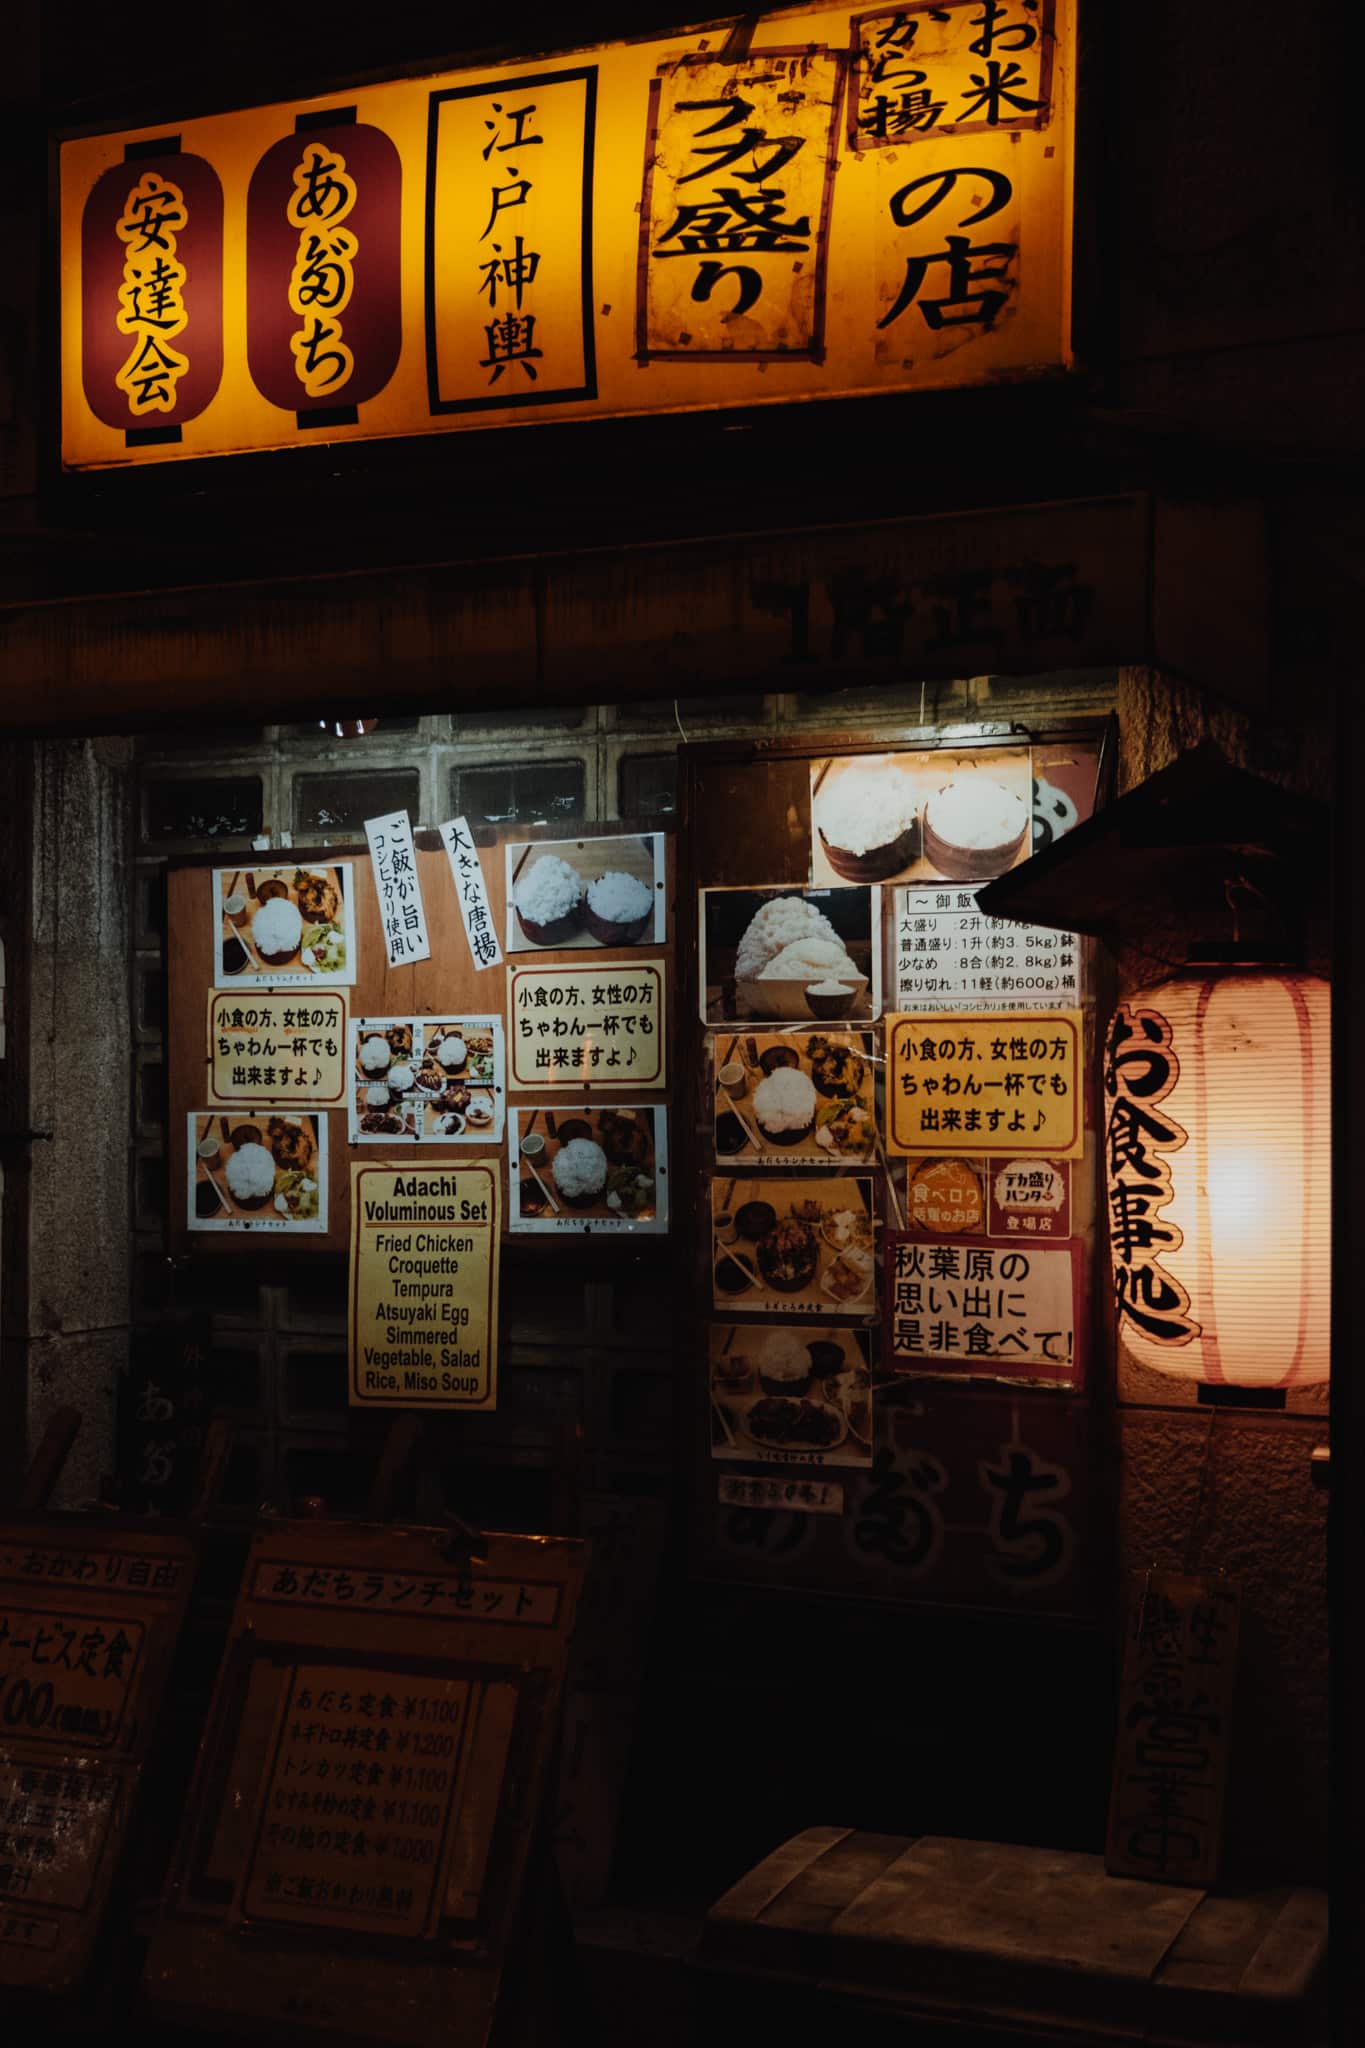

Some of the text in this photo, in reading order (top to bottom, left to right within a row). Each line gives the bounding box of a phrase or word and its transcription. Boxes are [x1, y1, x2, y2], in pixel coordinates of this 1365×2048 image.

[953, 0, 1049, 126] お米
[477, 102, 545, 387] 江戸神輿
[876, 166, 1020, 332] の店
[122, 181, 182, 406] 安達会
[373, 834, 406, 958] コシヒカリ使用
[899, 957, 938, 971] 少なめ
[518, 983, 654, 1008] 小食の方、女性の方
[217, 1008, 339, 1028] 小食の方、女性の方
[519, 1015, 654, 1037] ちゃわん一杯でも
[217, 1037, 339, 1058] ちゃわん一杯でも
[900, 1036, 1069, 1062] 小食の方、女性の方
[900, 1073, 1069, 1097] ちゃわん一杯でも
[393, 1176, 457, 1198] Adachi
[1104, 1011, 1192, 1340] お食事処
[365, 1200, 488, 1221] Voluminous Set
[376, 1234, 474, 1253] Fried Chicken
[388, 1256, 459, 1278] Croquette
[894, 1245, 1030, 1282] 秋葉原の
[392, 1279, 454, 1301] Tempura
[894, 1282, 1027, 1318] 思い出に
[376, 1303, 469, 1326] Atsuyaki Egg
[386, 1326, 458, 1345] Simmered
[364, 1348, 481, 1369] Vegetable, Salad
[365, 1371, 479, 1395] Rice, Miso Soup
[272, 1565, 535, 1617] あだちランチセット
